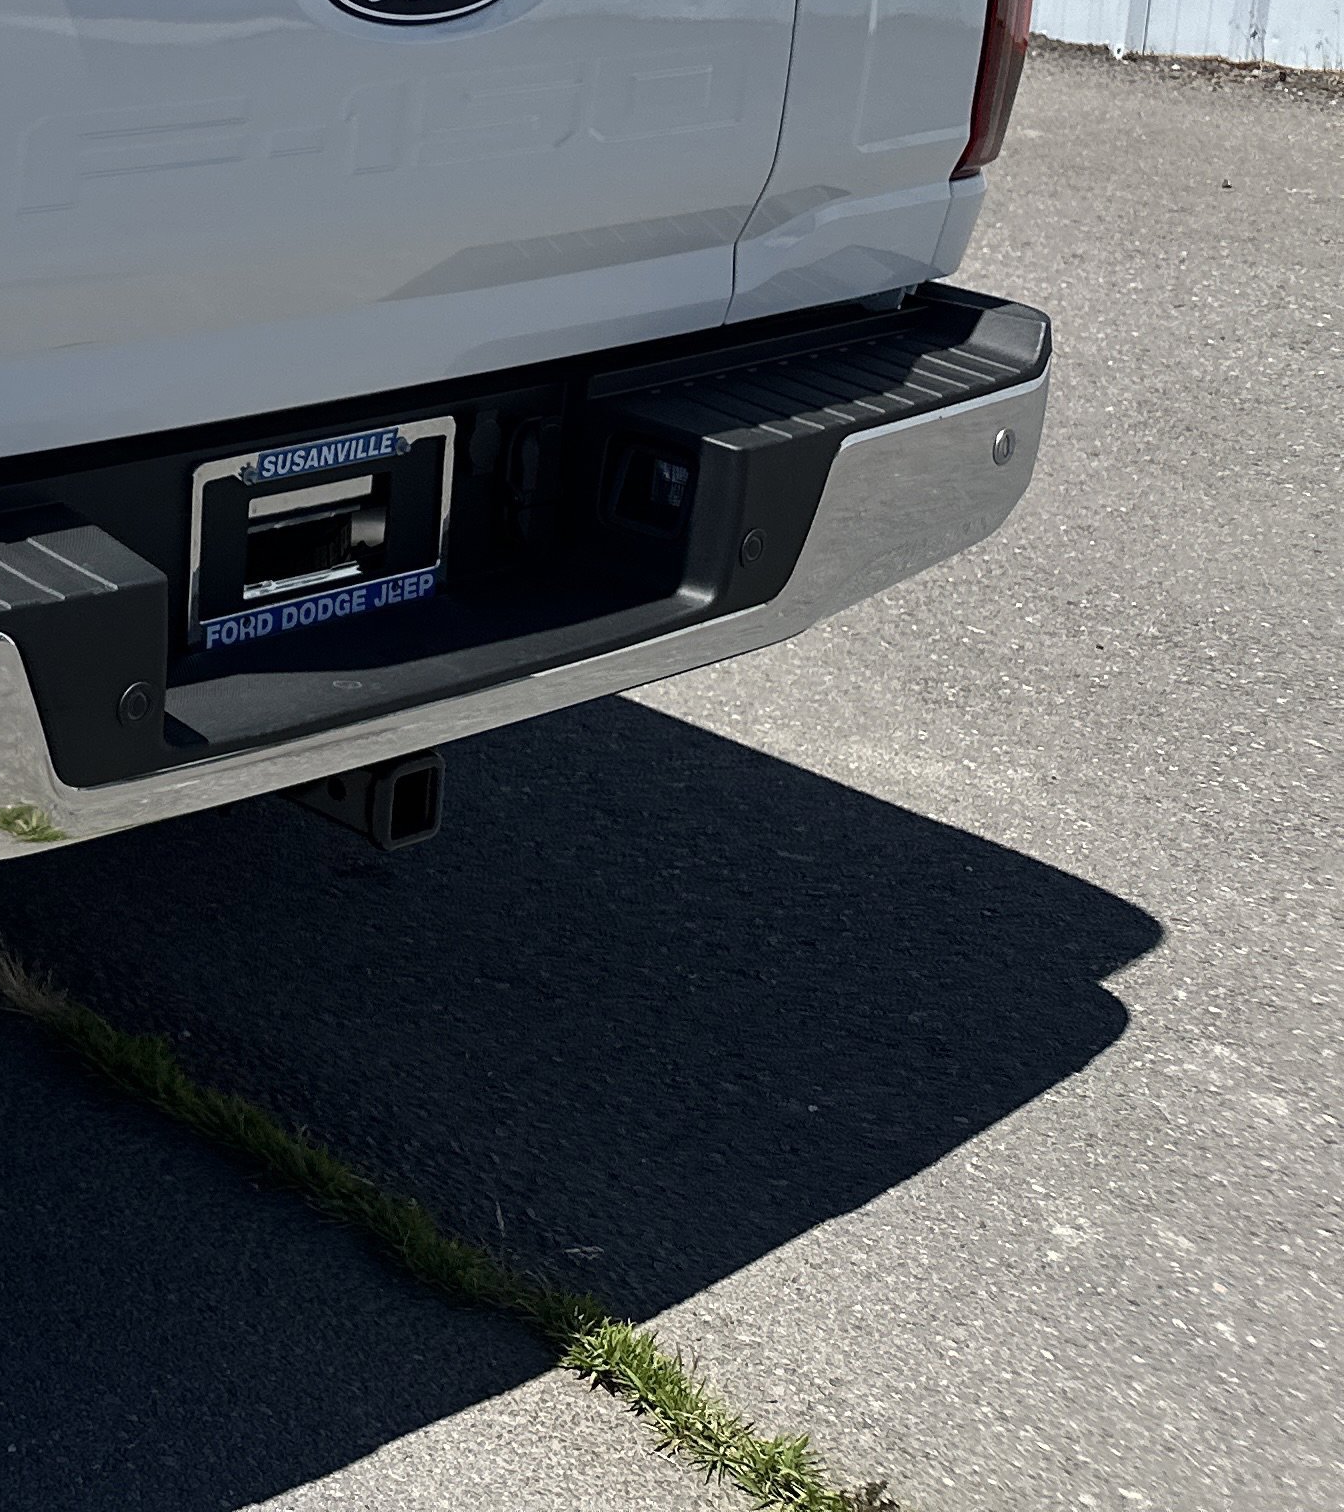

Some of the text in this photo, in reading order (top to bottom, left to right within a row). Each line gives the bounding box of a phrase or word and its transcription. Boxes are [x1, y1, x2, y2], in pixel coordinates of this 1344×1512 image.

[261, 432, 394, 478] SUSANVILLE
[205, 573, 434, 649] FORD DODGE JEEP
